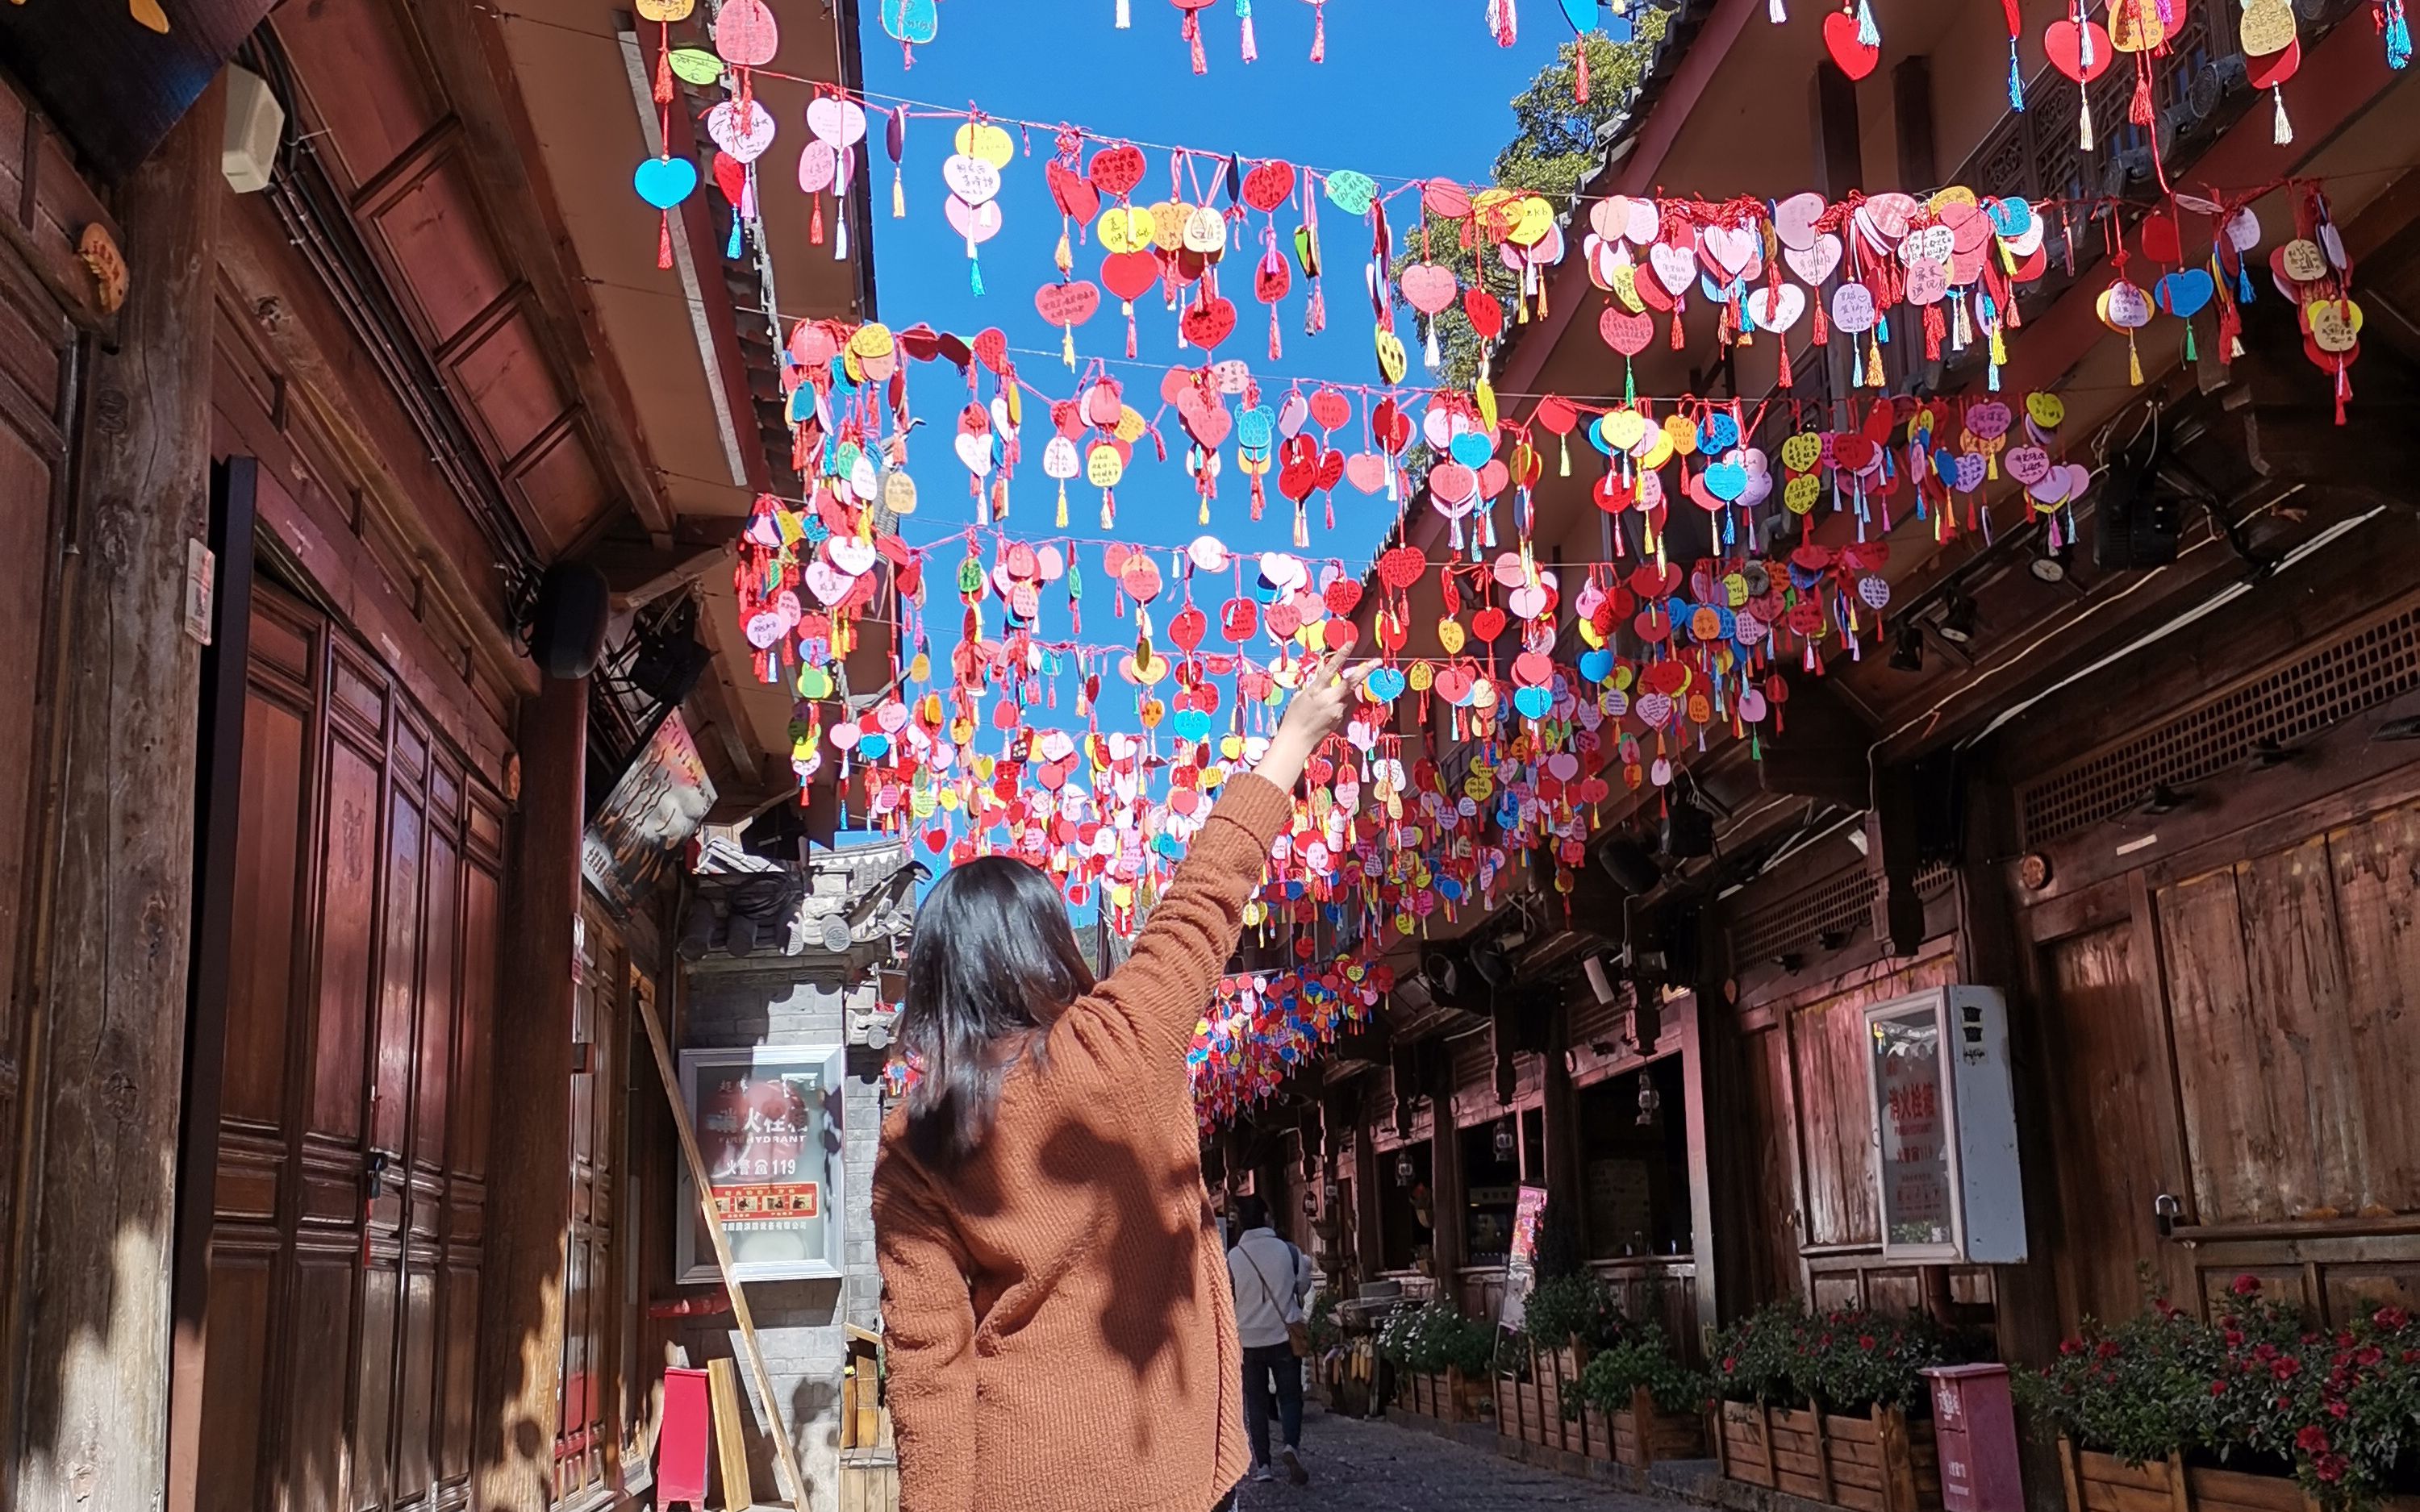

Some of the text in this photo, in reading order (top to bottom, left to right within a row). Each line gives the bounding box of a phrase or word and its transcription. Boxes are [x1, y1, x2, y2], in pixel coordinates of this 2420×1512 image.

[1889, 1081, 1935, 1122] 消火栓箱
[747, 1135, 807, 1143] HYDRANT
[773, 1159, 796, 1175] 119
